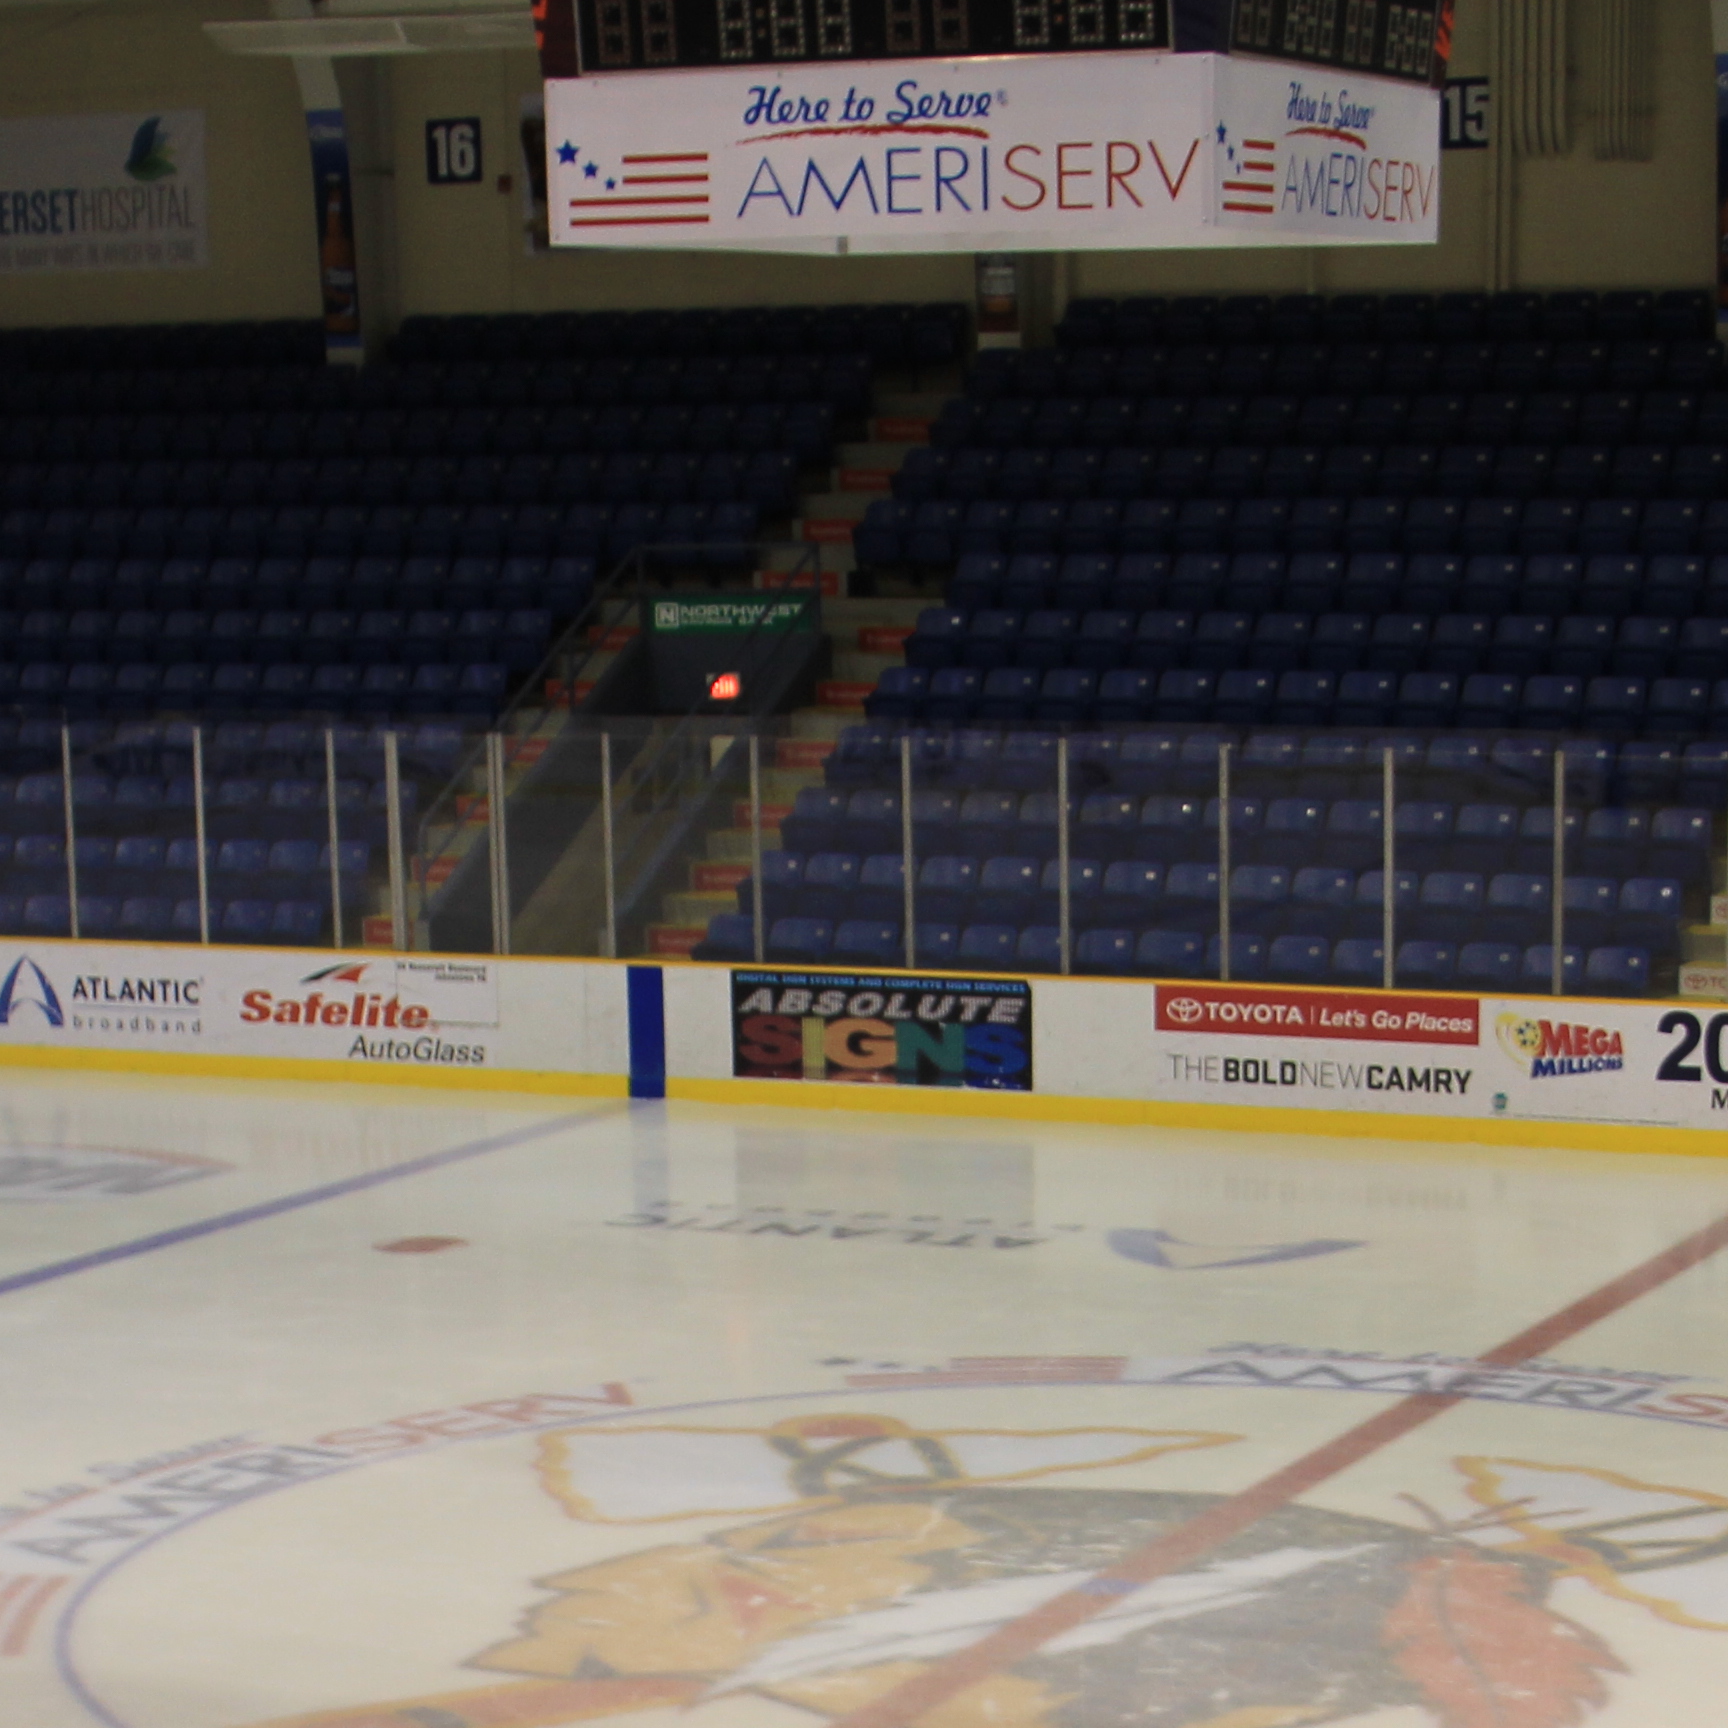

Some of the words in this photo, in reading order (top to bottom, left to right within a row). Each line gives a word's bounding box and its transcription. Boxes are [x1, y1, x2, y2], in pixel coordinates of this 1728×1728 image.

[743, 84, 829, 127] Here
[843, 89, 876, 123] to
[885, 79, 992, 124] Serve
[1286, 82, 1321, 127] Here
[1321, 92, 1334, 126] to
[1334, 88, 1370, 131] Serve
[1444, 85, 1489, 142] 15
[432, 126, 474, 177] 16
[737, 139, 1200, 219] AMERISERV
[1283, 150, 1435, 224] AMERISERV
[72, 976, 200, 1005] ATLANTIC
[858, 976, 882, 988] AND
[884, 977, 943, 990] COMPLETE
[73, 1011, 202, 1036] broadband
[240, 989, 430, 1030] Safelite
[738, 987, 1025, 1024] ABSOLUTE
[1206, 1001, 1303, 1025] TOYOTA
[1319, 1006, 1366, 1028] Let's
[1372, 1009, 1401, 1030] Go
[1405, 1011, 1473, 1032] Places
[348, 1033, 485, 1064] AutoGlass
[738, 1014, 1030, 1075] SIGNS
[1536, 1019, 1624, 1059] MEGA
[1530, 1055, 1624, 1079] MILLIONS
[6, 1380, 635, 1566] AMERISERV
